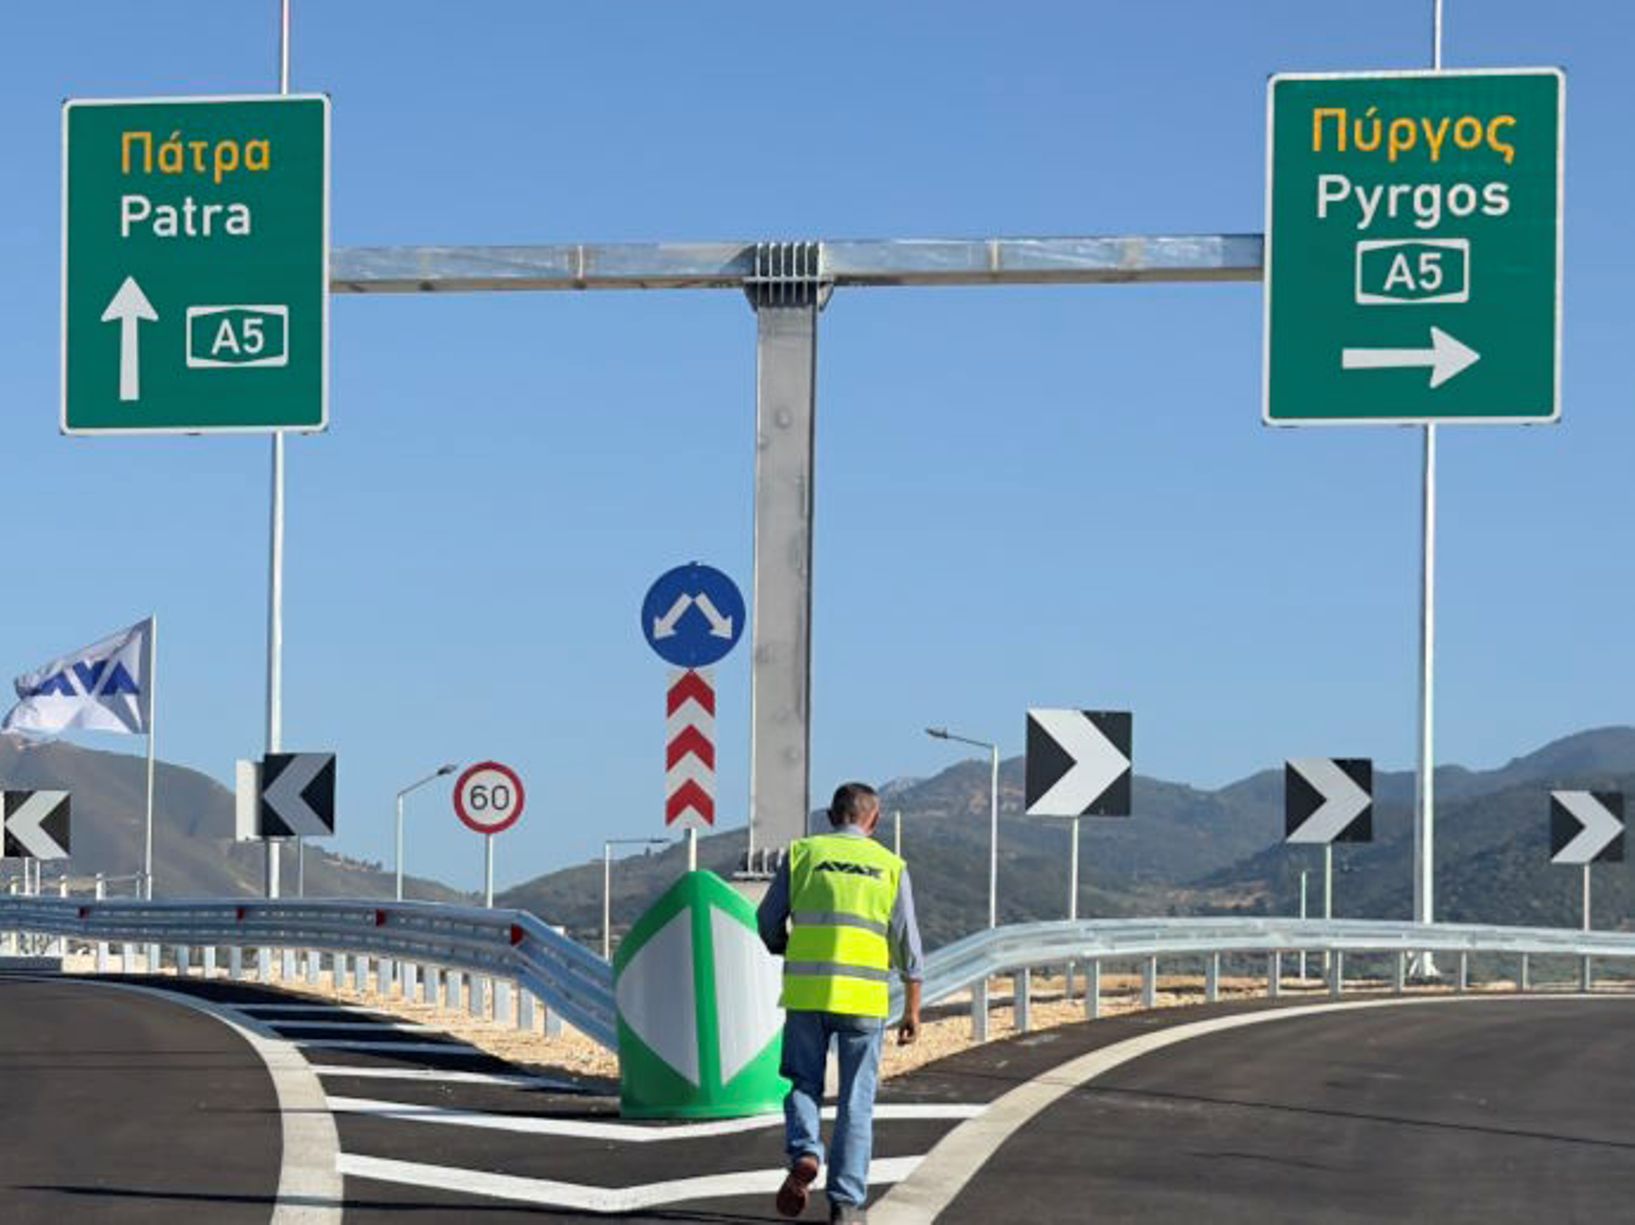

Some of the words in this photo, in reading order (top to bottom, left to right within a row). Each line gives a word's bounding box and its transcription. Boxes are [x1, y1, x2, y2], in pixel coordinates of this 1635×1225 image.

[120, 130, 271, 184] Πάτρα
[1311, 106, 1517, 165] Πύργος
[120, 195, 251, 238] Patra
[1316, 173, 1511, 230] Pyrgos
[1383, 252, 1443, 291] A5
[211, 317, 265, 355] A5
[470, 785, 509, 811] 60
